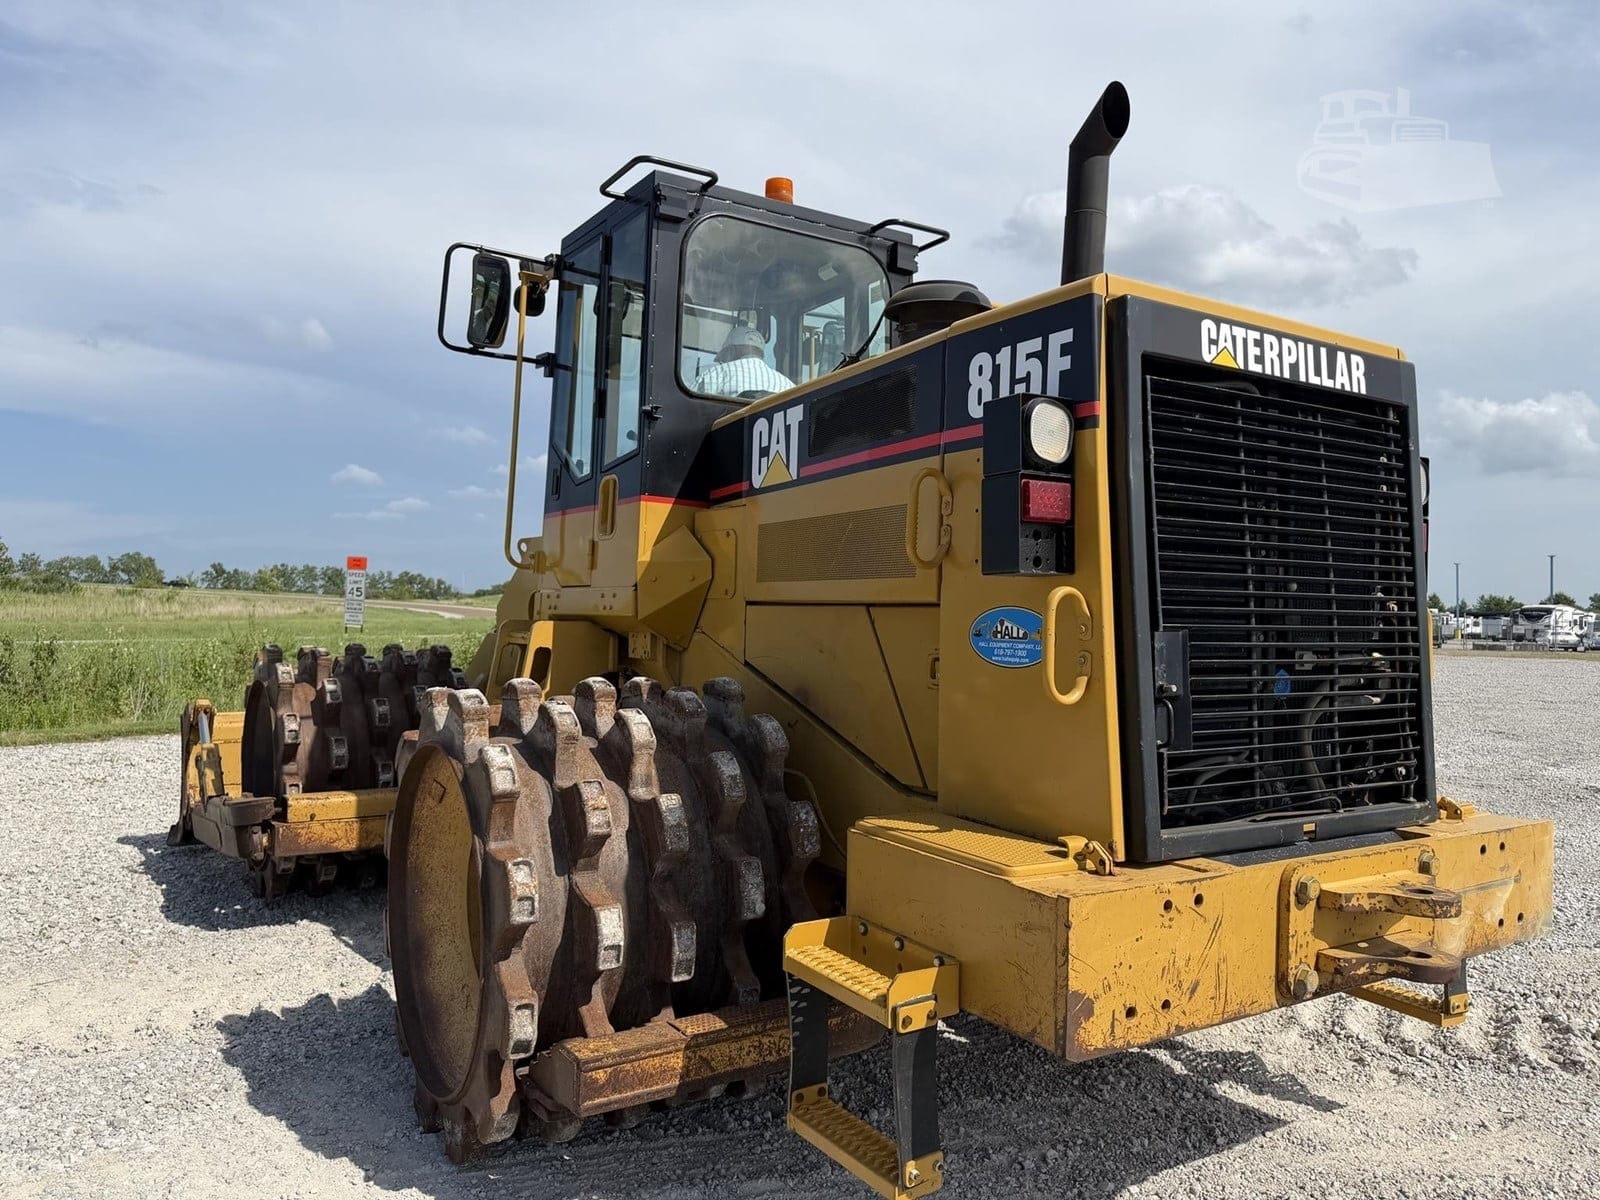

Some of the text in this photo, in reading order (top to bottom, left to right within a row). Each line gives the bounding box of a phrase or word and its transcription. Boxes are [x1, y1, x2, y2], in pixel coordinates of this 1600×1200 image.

[968, 328, 1074, 419] 815F
[1201, 318, 1367, 395] CATERPILLAR
[752, 403, 804, 489] CAT
[348, 587, 363, 598] 45
[995, 625, 1026, 640] HALL
